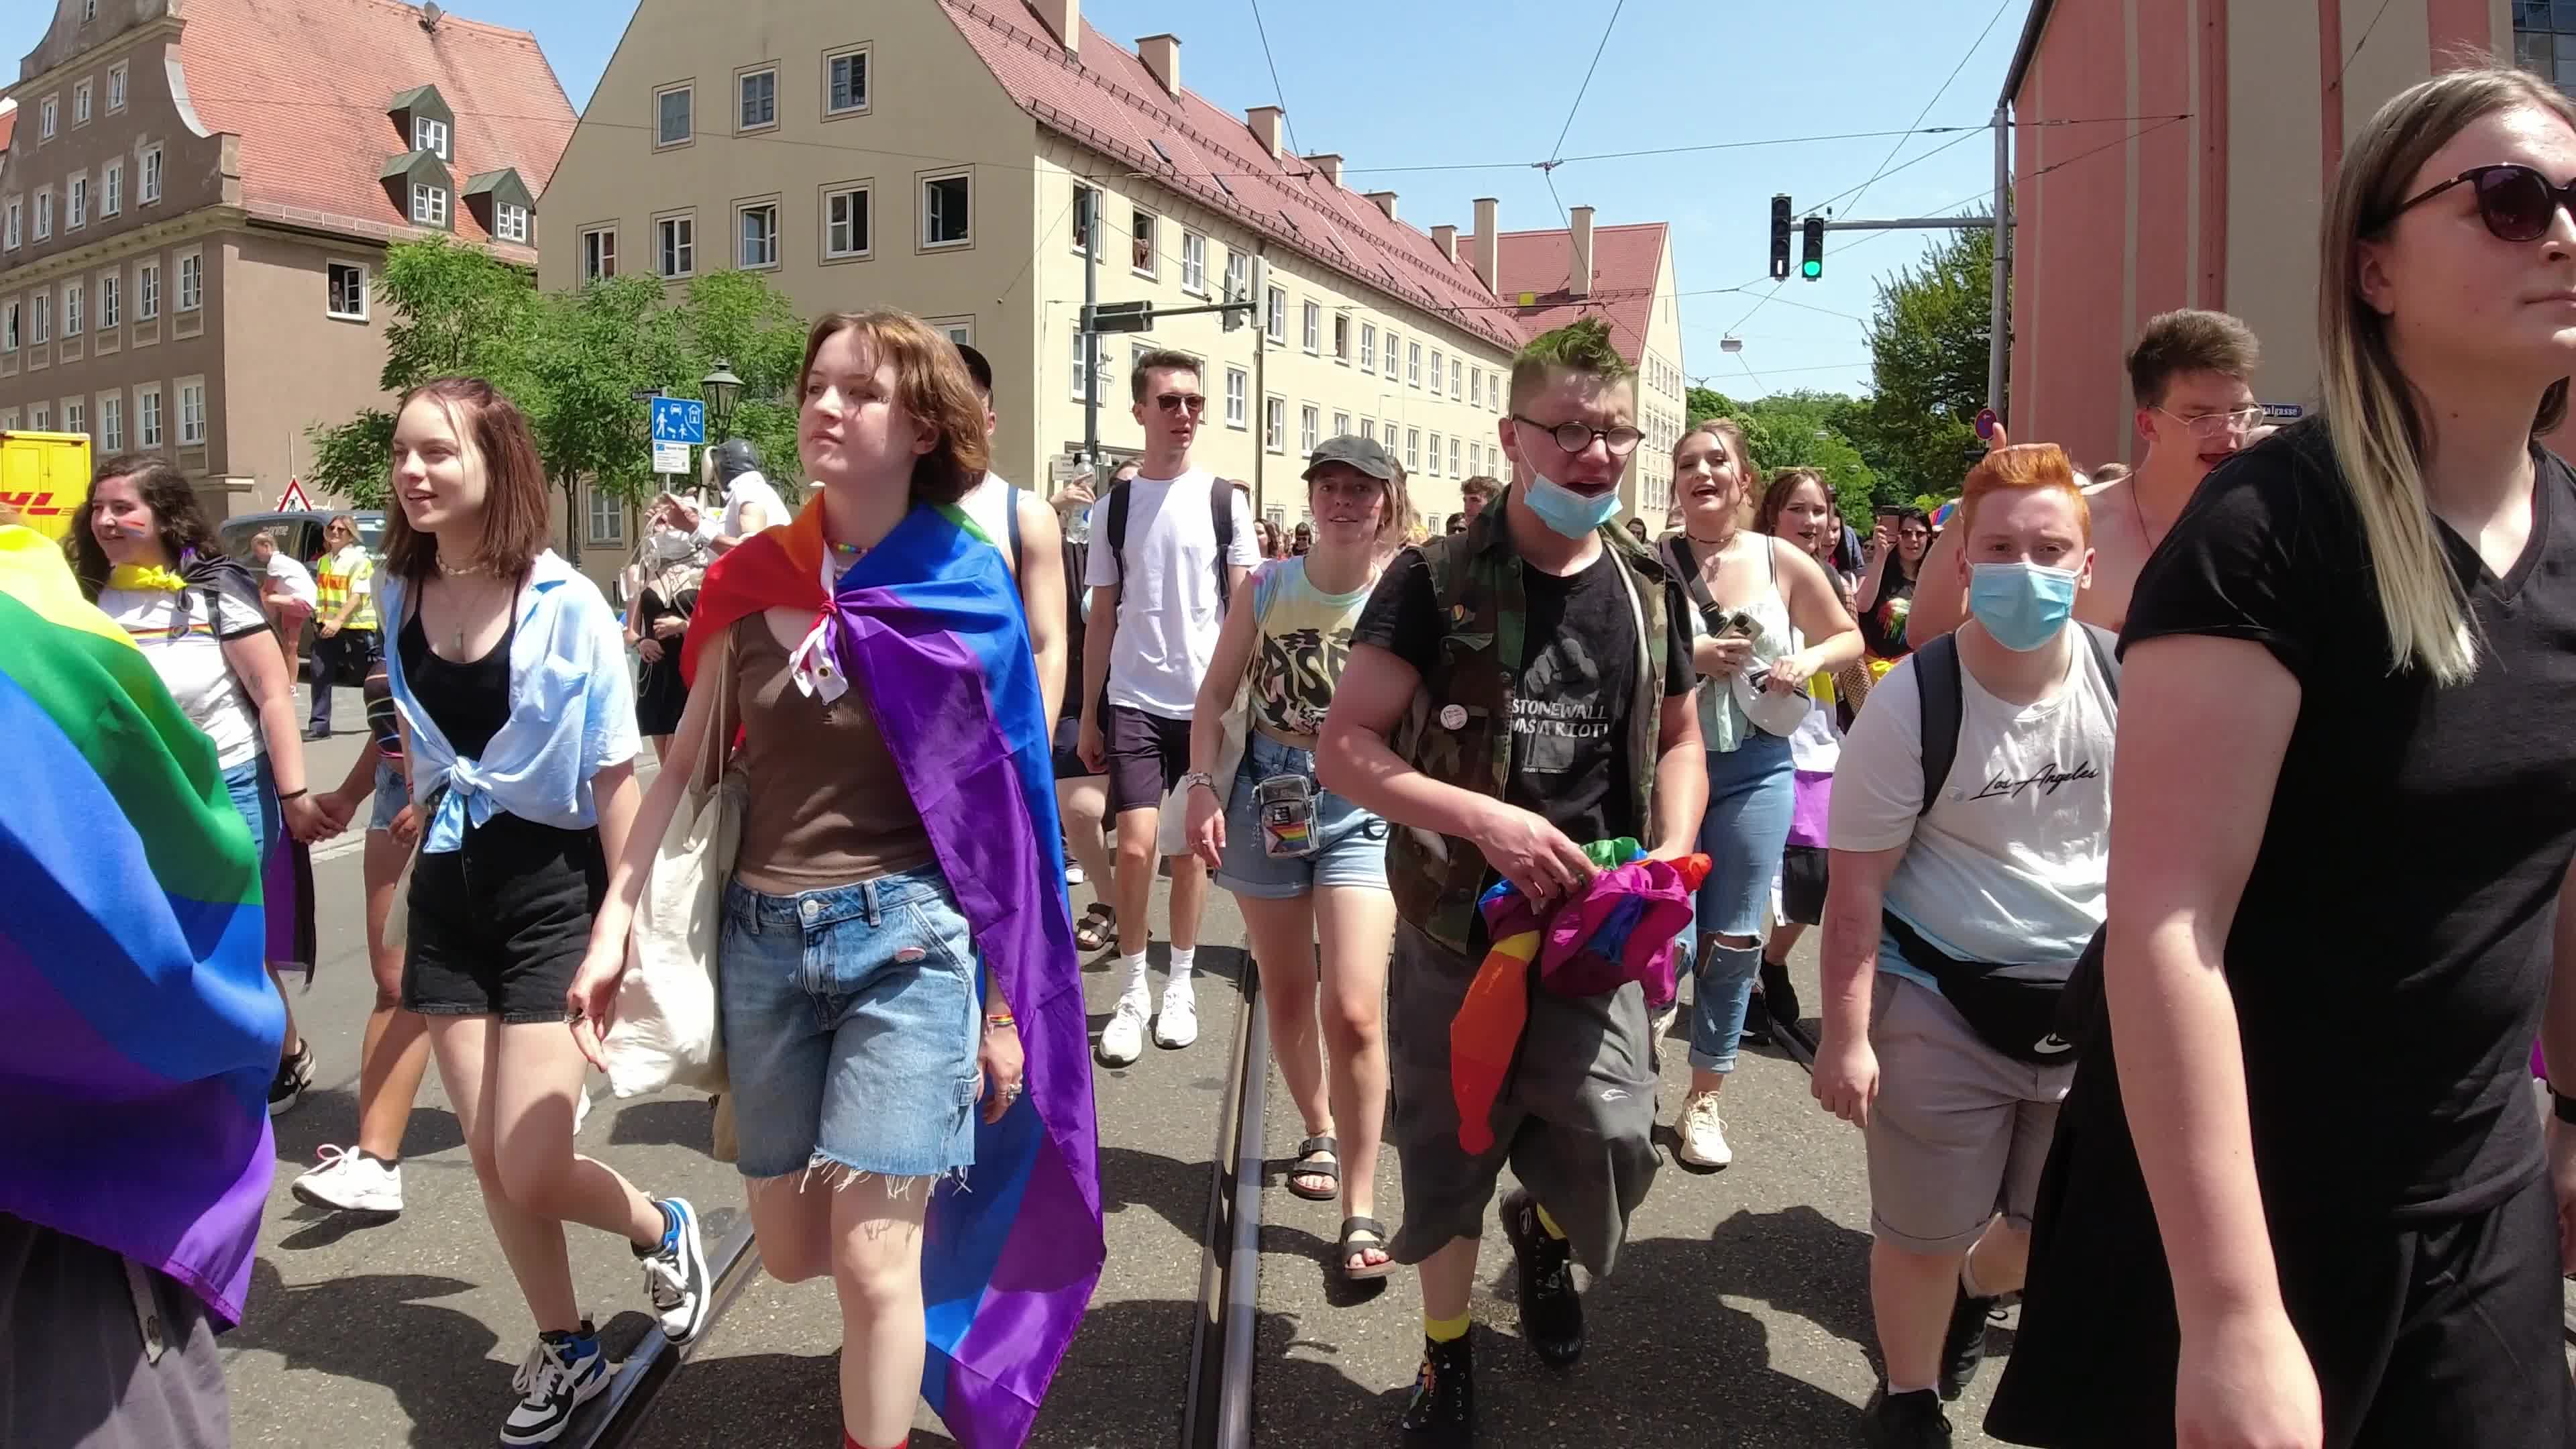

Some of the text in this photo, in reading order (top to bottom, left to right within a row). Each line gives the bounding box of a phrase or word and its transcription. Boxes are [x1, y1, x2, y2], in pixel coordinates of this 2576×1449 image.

[0, 492, 61, 515] HL
[1512, 698, 1608, 720] STONEWALL
[1538, 720, 1551, 736] A
[1969, 761, 2099, 801] Los Angeles
